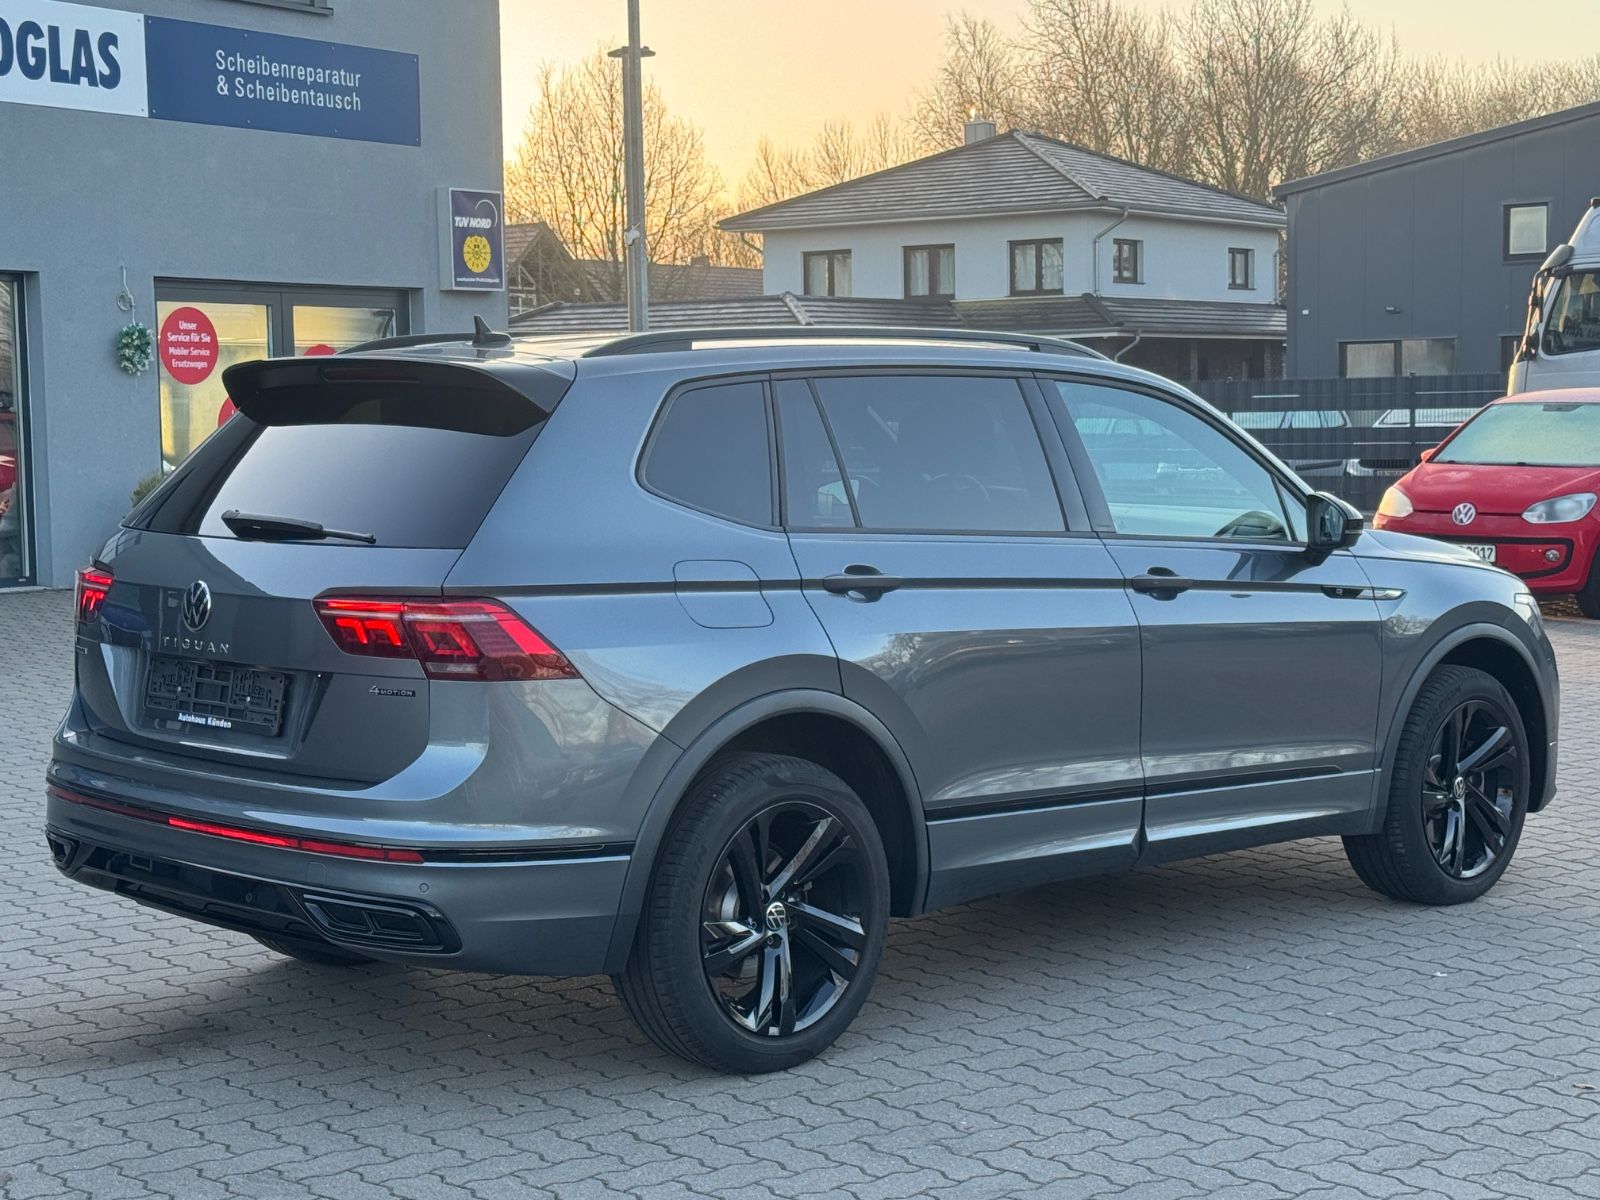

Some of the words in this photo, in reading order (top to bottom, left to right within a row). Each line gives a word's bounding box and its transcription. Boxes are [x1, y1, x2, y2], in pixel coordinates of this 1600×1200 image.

[215, 49, 361, 88] Scheibenreparatur
[216, 74, 229, 96] &
[234, 77, 361, 111] Scheibentausch
[454, 216, 470, 228] TÜV
[469, 217, 492, 229] NORD
[178, 320, 198, 331] Unser
[167, 332, 190, 342] Service
[190, 332, 201, 342] für
[201, 333, 211, 343] Sie
[168, 346, 189, 356] Mobiler
[190, 347, 210, 357] Service
[162, 636, 230, 654] TIGUAN
[369, 685, 413, 697] 4MOTION
[177, 712, 206, 725] Autohaus
